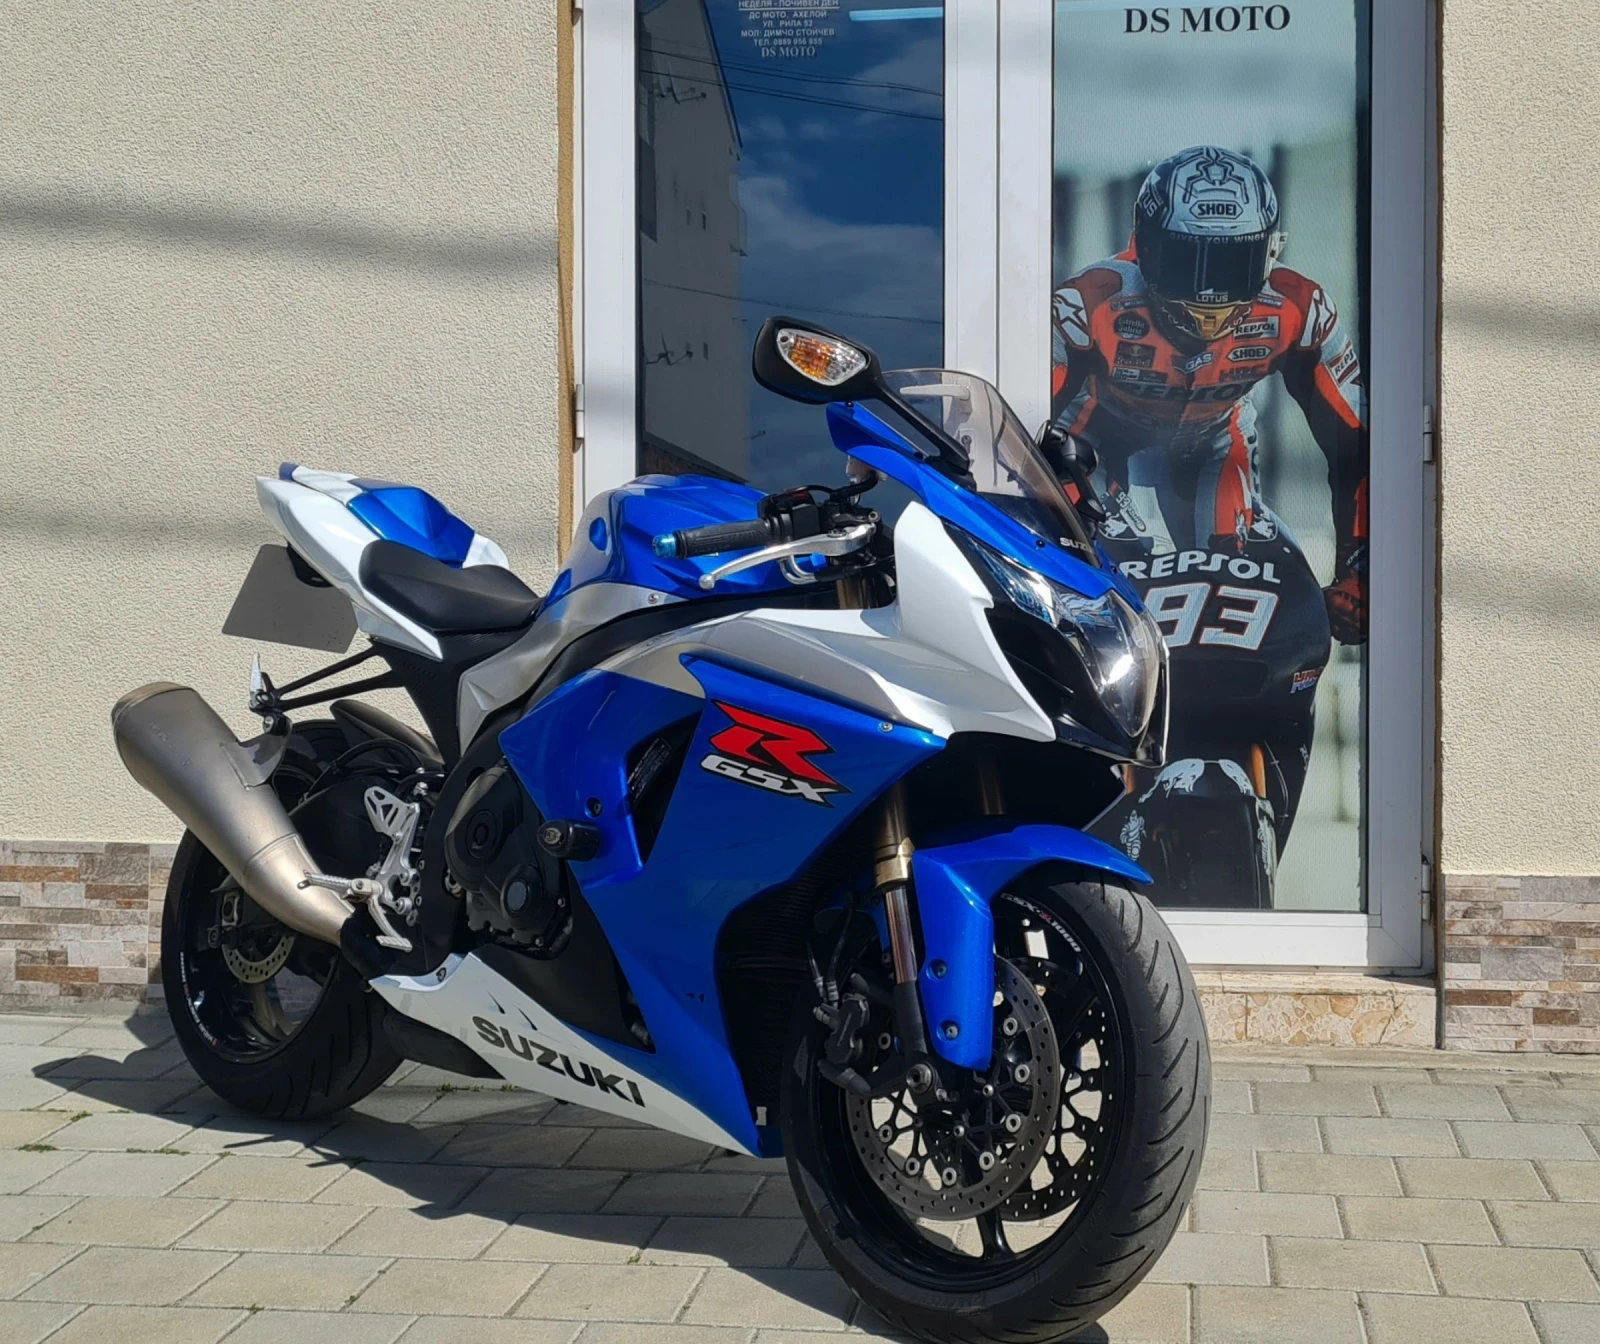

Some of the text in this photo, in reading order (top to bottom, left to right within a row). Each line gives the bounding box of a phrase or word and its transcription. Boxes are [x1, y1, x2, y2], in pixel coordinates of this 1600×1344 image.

[792, 9, 827, 18] АХЕЛОЙ
[1123, 5, 1290, 34] DS MOTO
[761, 45, 816, 58] DS MOTO
[1197, 203, 1237, 217] SHOEI
[1206, 236, 1229, 245] YOU
[1196, 293, 1229, 303] LOTUS
[1235, 322, 1277, 334] REPSOL
[1185, 353, 1213, 371] GAS
[1232, 348, 1267, 360] SHOEI
[1115, 491, 1132, 509] 93
[1118, 550, 1281, 584] REPSOL
[1143, 581, 1279, 651] 93
[700, 754, 839, 803] GSX
[472, 1016, 646, 1108] SUZUKI
